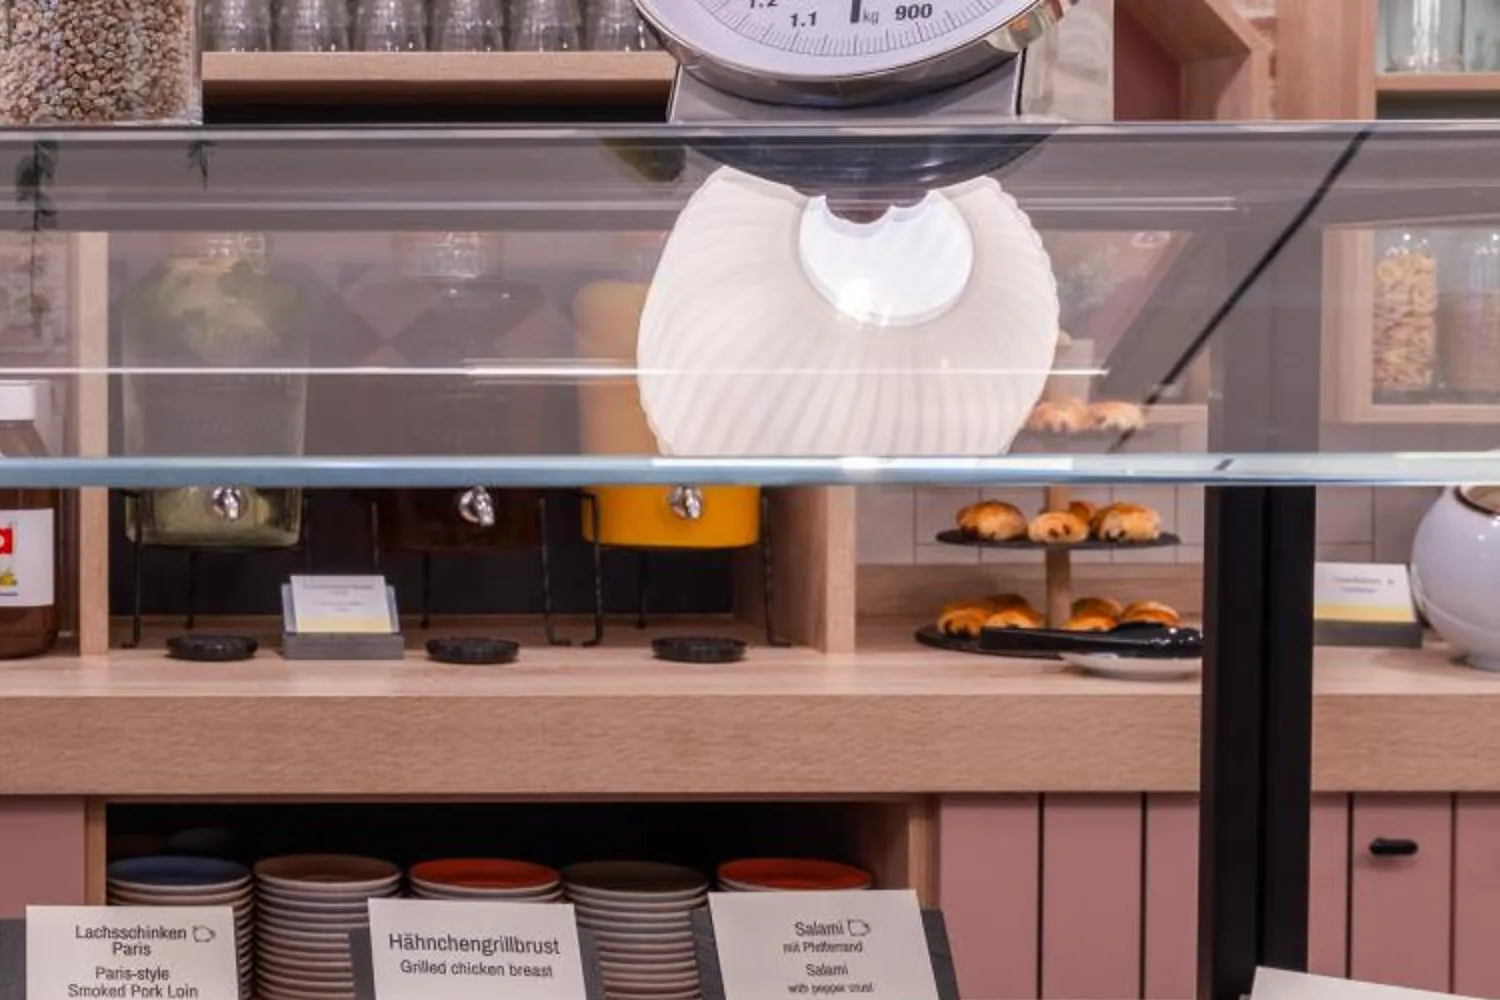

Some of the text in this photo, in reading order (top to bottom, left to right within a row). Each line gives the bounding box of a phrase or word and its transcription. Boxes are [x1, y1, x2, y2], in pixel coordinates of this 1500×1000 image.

[790, 12, 817, 28] 1.1
[895, 3, 933, 21] 900
[75, 925, 187, 940] Lachsschinken
[795, 921, 845, 937] Salami
[112, 942, 152, 956] Paris
[389, 933, 560, 956] Hähnchengrillbrust
[95, 966, 169, 982] Paris-style
[400, 960, 553, 977] Grilled chicken breast
[805, 963, 849, 976] Salami
[68, 983, 199, 999] Smoked Pork Loin
